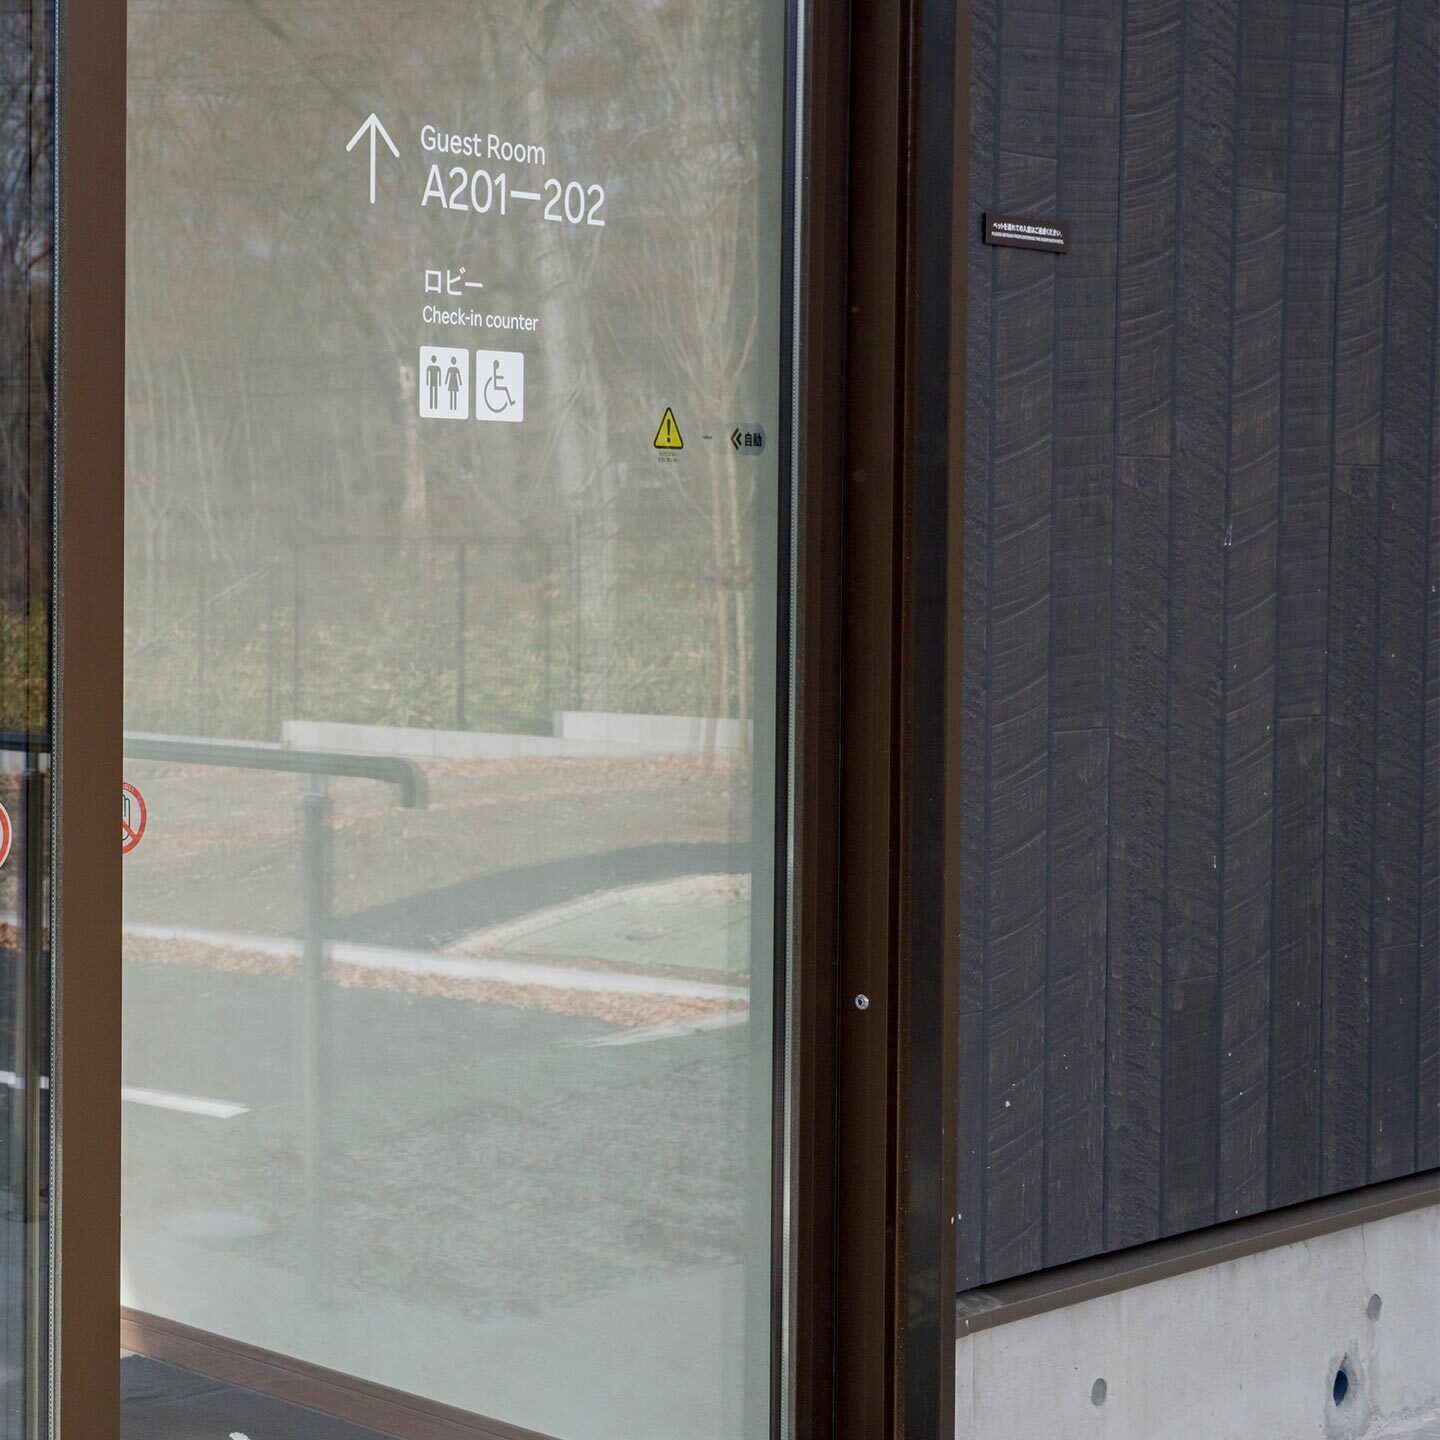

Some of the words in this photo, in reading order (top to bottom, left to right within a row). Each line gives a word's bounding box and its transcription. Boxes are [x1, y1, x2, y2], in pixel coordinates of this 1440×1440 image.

[421, 125, 482, 158] Guest
[487, 133, 546, 166] Room
[425, 267, 483, 296] ロビー
[422, 305, 483, 328] Check-in
[485, 314, 539, 331] counter
[744, 432, 763, 448] 自動
